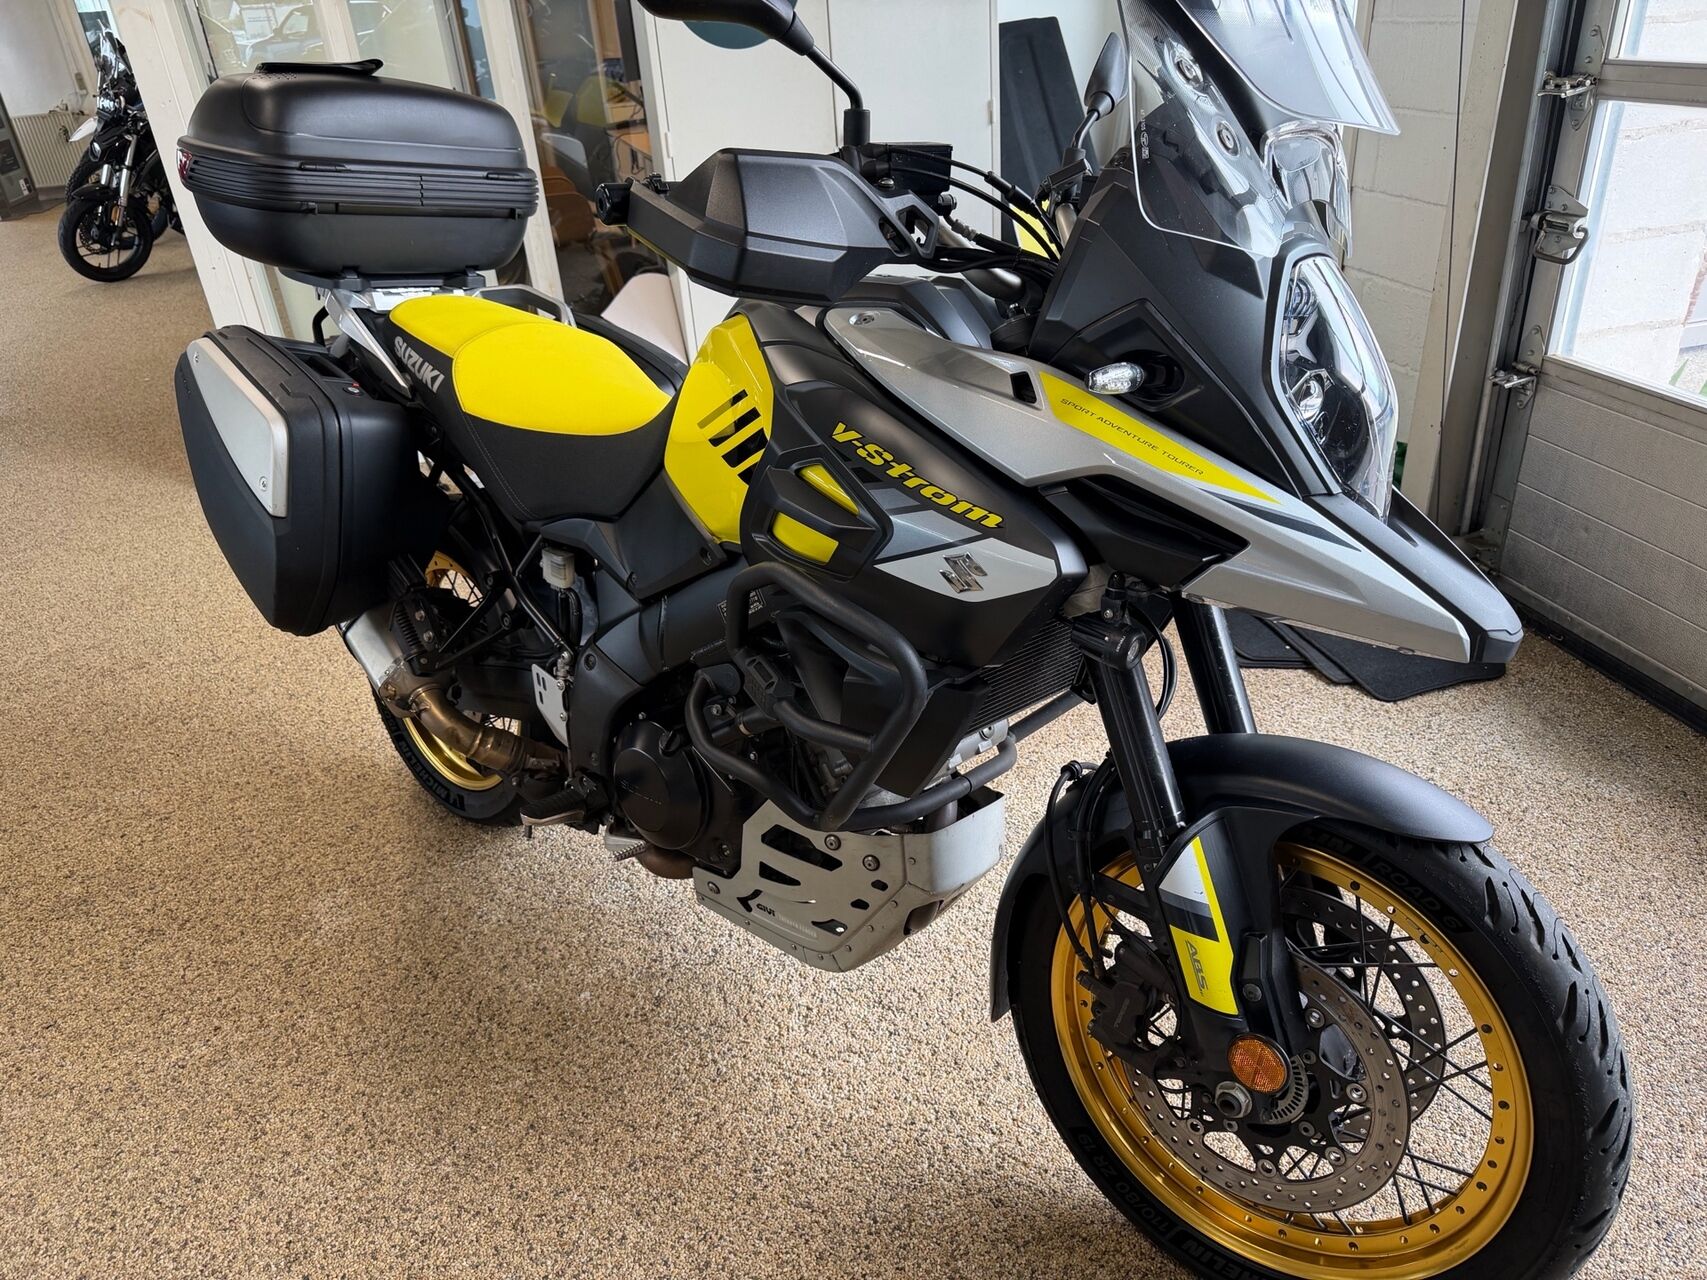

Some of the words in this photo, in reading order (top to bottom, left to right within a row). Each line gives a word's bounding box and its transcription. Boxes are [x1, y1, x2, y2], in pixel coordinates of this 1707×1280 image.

[394, 336, 445, 393] SUZUKI
[1060, 398, 1097, 417] SPORT
[1096, 416, 1160, 451] ADVENTURE
[1162, 450, 1204, 475] TOURER
[399, 741, 450, 800] MICHELIN
[756, 903, 776, 917] GIVI
[1371, 860, 1442, 913] ROAD
[1442, 913, 1463, 930] 6
[1186, 939, 1209, 991] ABS
[1114, 1182, 1172, 1233] 110/80
